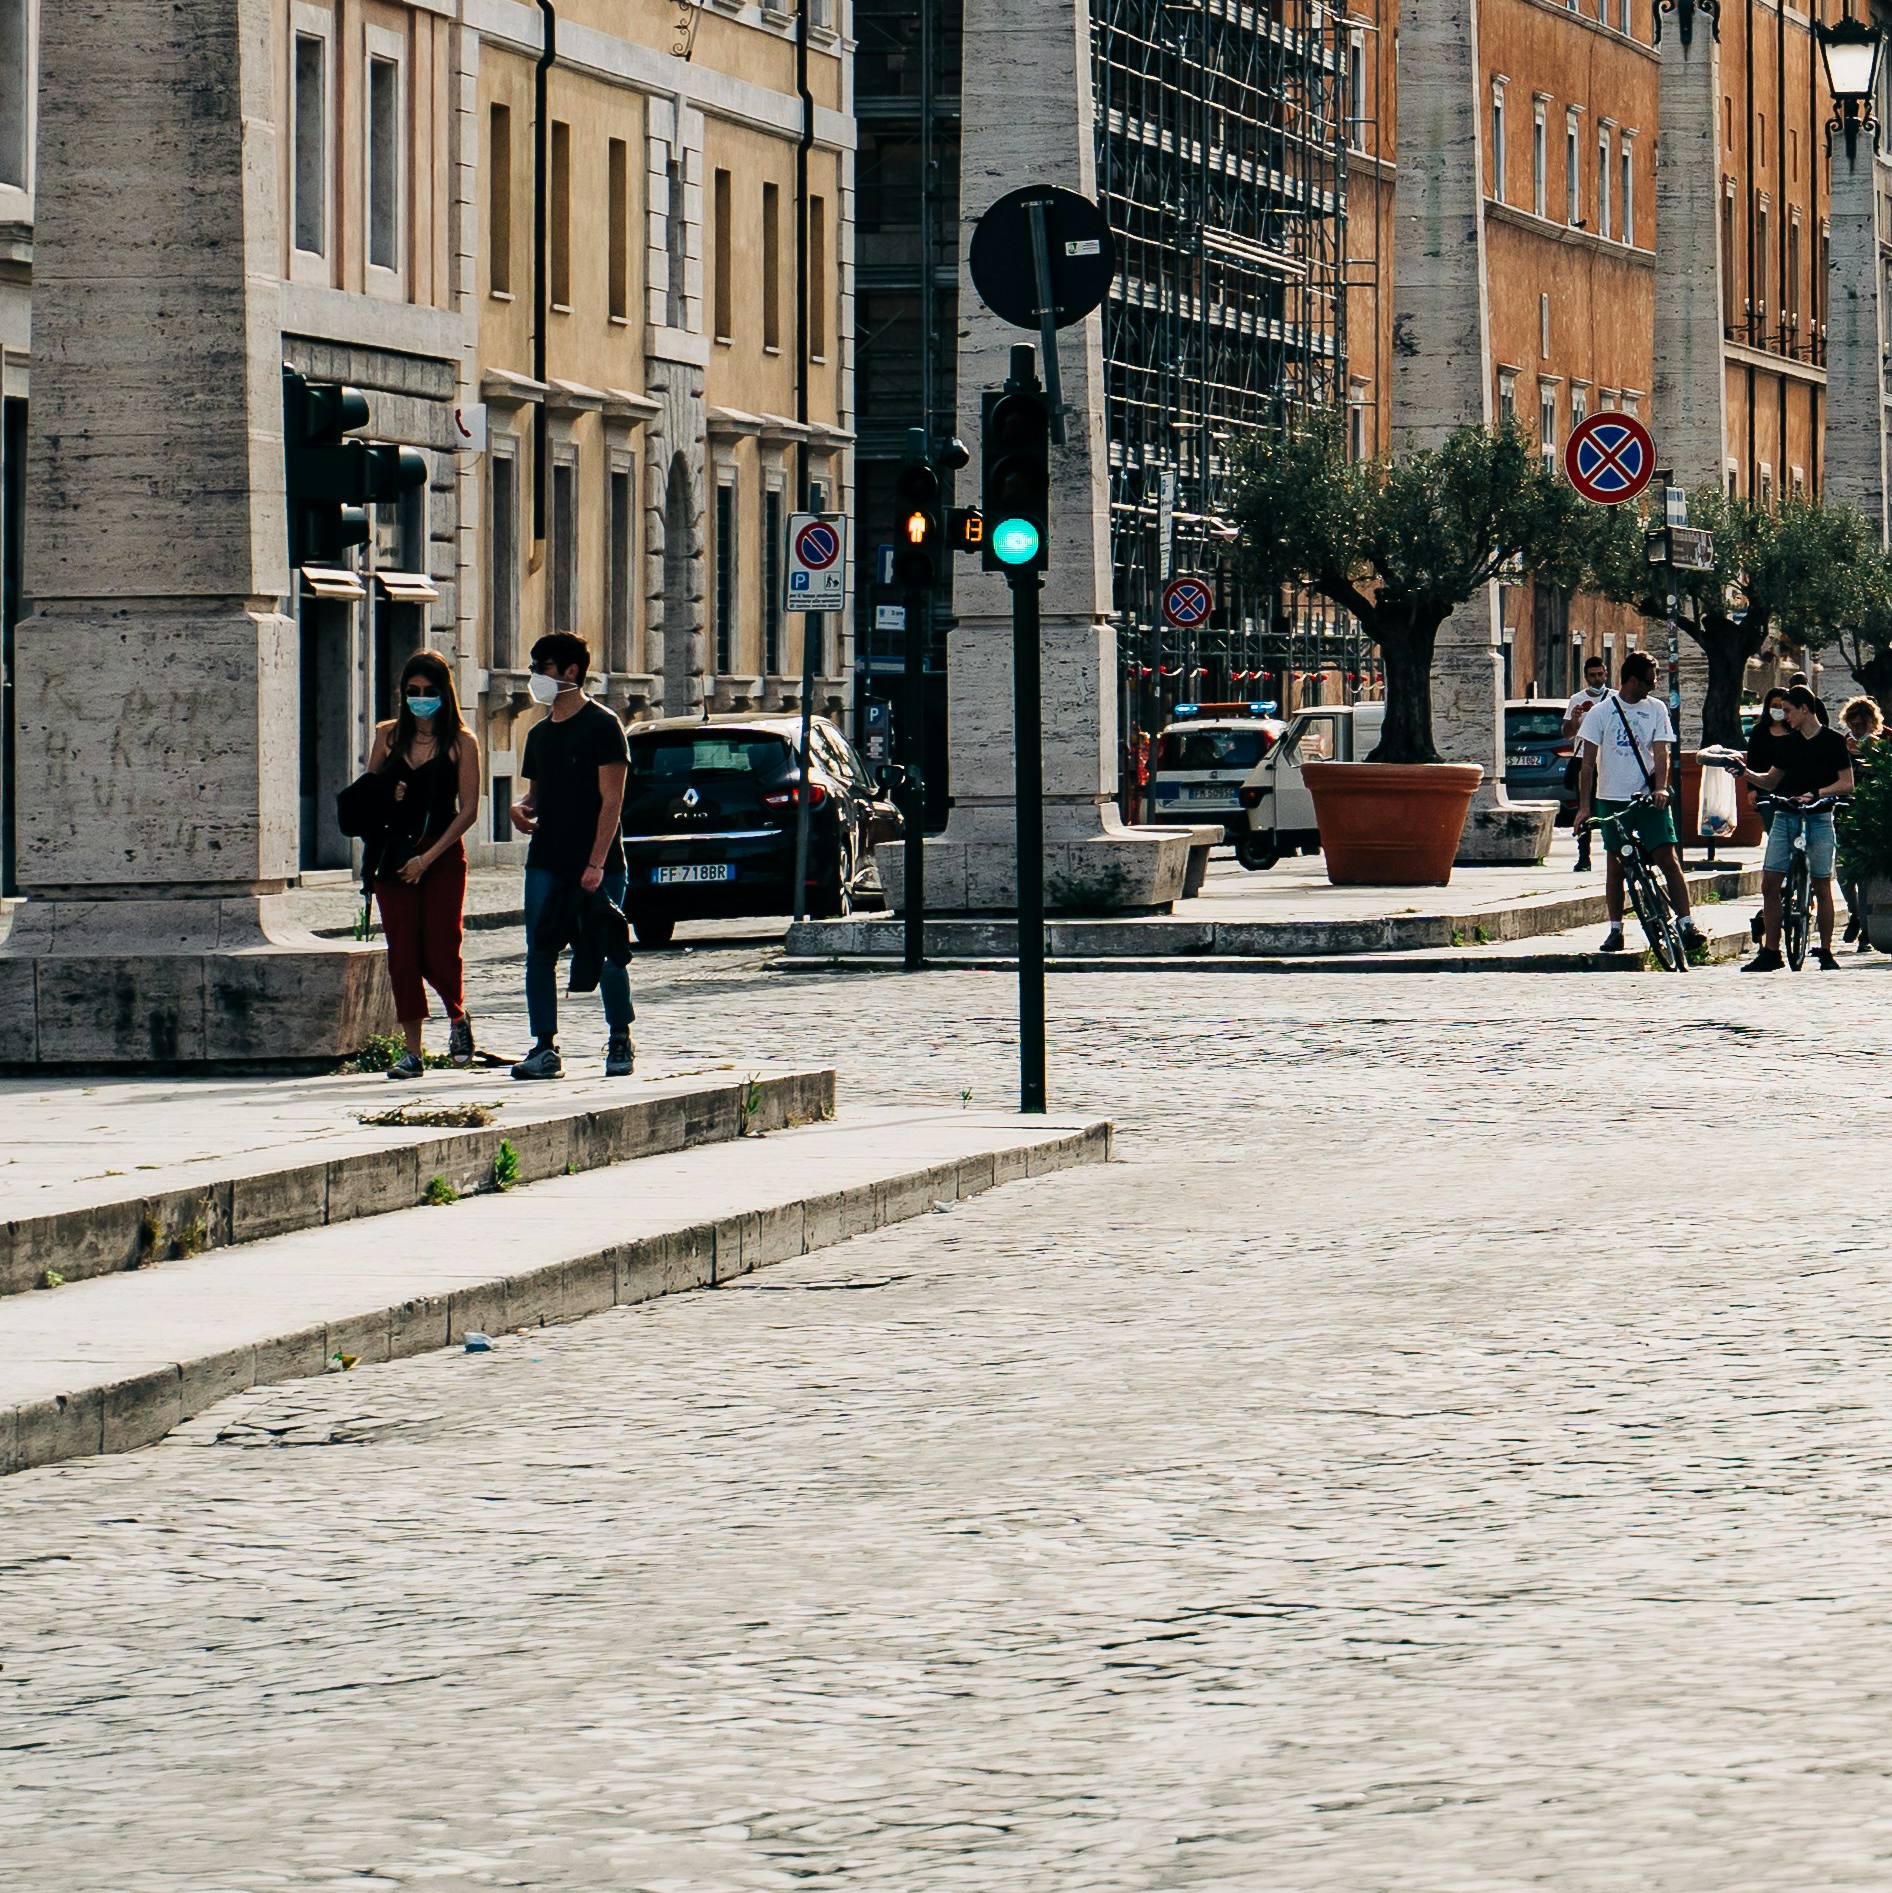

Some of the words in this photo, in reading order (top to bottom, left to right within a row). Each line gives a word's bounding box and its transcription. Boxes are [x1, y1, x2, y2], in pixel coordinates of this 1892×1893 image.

[965, 519, 982, 541] 13
[660, 868, 677, 881] FF
[682, 865, 726, 880] 718BR
